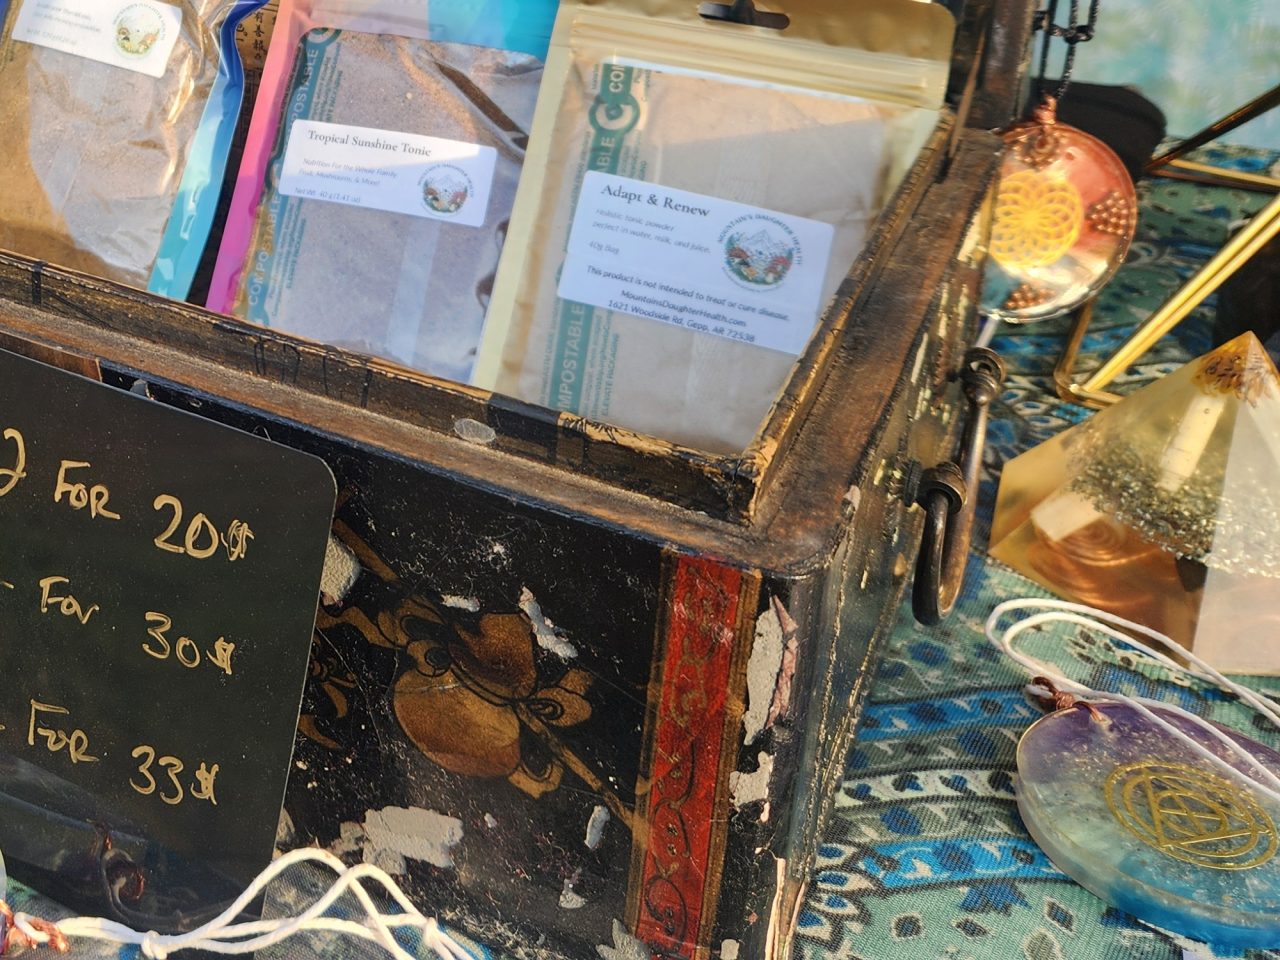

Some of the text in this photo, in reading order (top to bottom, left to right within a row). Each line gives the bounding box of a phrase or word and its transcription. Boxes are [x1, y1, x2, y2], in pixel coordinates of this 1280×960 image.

[307, 129, 432, 158] Tropical Sunshine Tonic
[600, 183, 711, 218] Adapt & Renew
[592, 220, 620, 234] perfect
[673, 239, 690, 249] and
[586, 264, 603, 277] This
[602, 269, 635, 286] product
[642, 279, 658, 290] not
[657, 281, 695, 301] intended
[694, 290, 705, 301] to
[737, 301, 758, 314] cure
[620, 289, 748, 329] MountainsDaughterHealth.com
[607, 298, 629, 313] 1621
[630, 304, 671, 323] Woodside
[710, 324, 727, 336] AR
[53, 459, 121, 522] FOR
[151, 493, 256, 563] 20$
[141, 611, 235, 676] 30$
[128, 744, 220, 807] 33$
